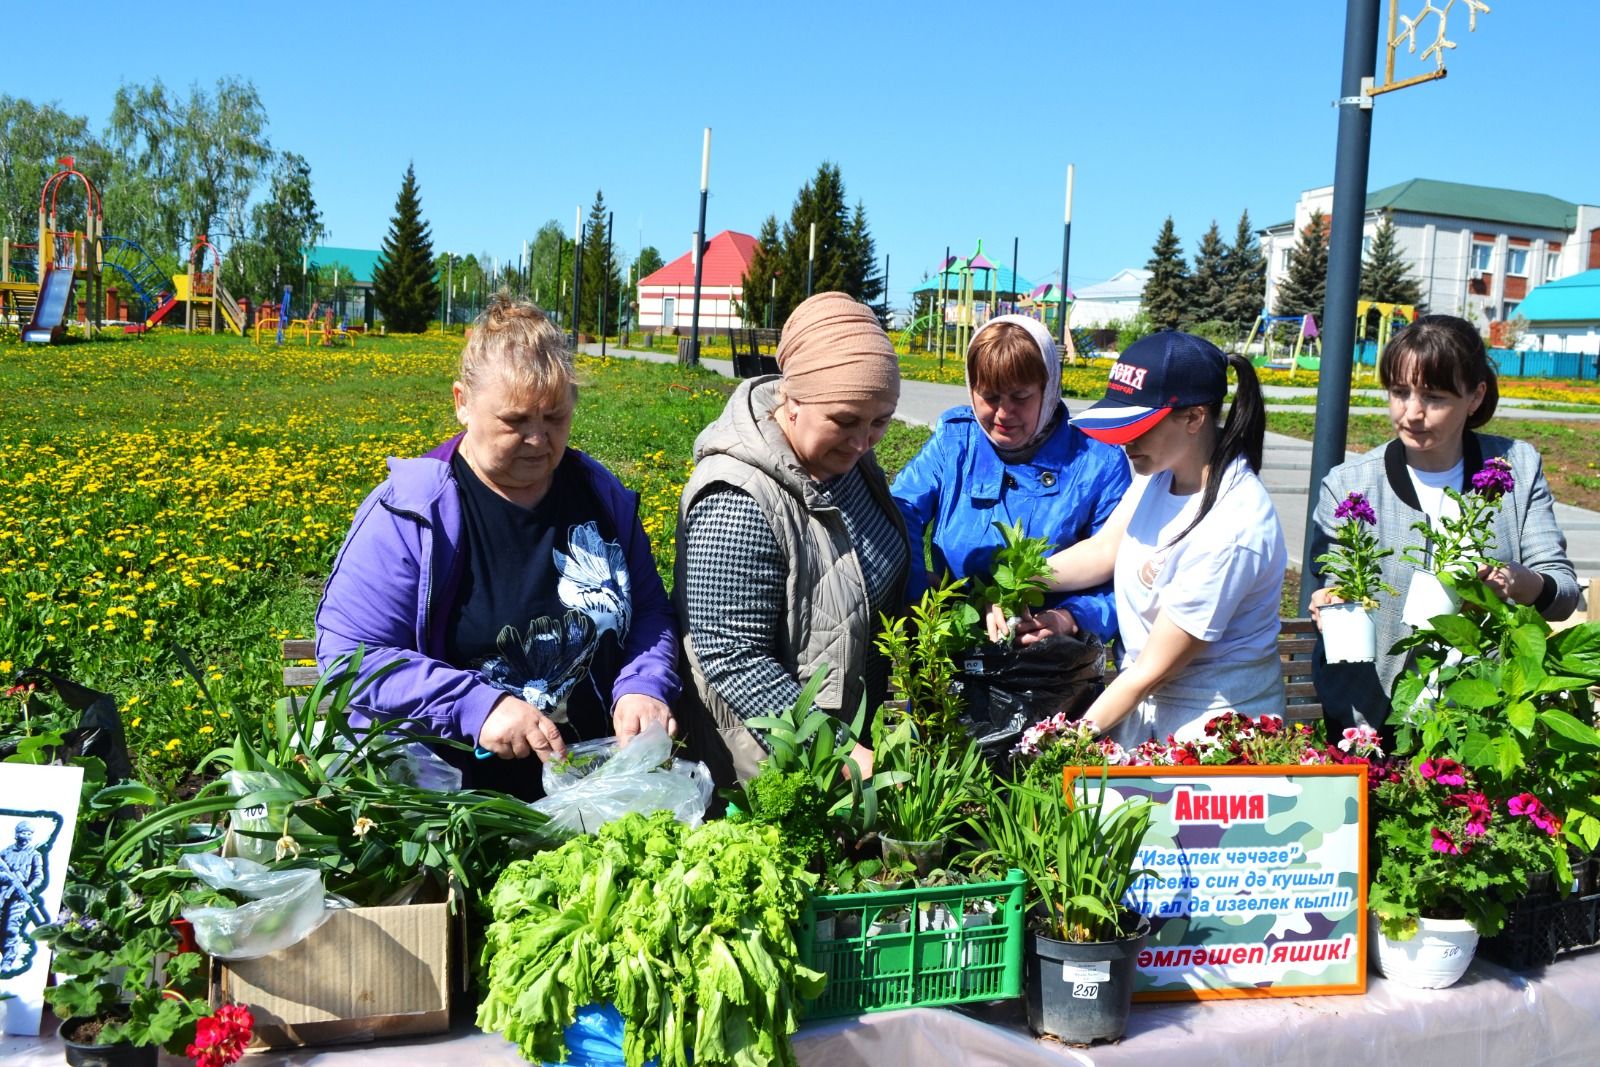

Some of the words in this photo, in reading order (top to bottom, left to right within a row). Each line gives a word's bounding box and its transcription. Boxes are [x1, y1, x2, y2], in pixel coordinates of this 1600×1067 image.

[1175, 790, 1264, 824] Акция
[1226, 846, 1299, 864] чәчәге”
[1127, 876, 1200, 893] иясенә
[1205, 875, 1240, 889] син
[1245, 870, 1267, 888] дә
[1272, 872, 1335, 890] кушыл
[1159, 900, 1182, 914] ал
[1187, 895, 1210, 912] да
[1216, 896, 1290, 912] изгелек
[1294, 891, 1349, 910] кыл!!!
[1137, 946, 1264, 968] әмләшеп
[1271, 937, 1351, 963] яшик!
[1073, 983, 1098, 997] 250
